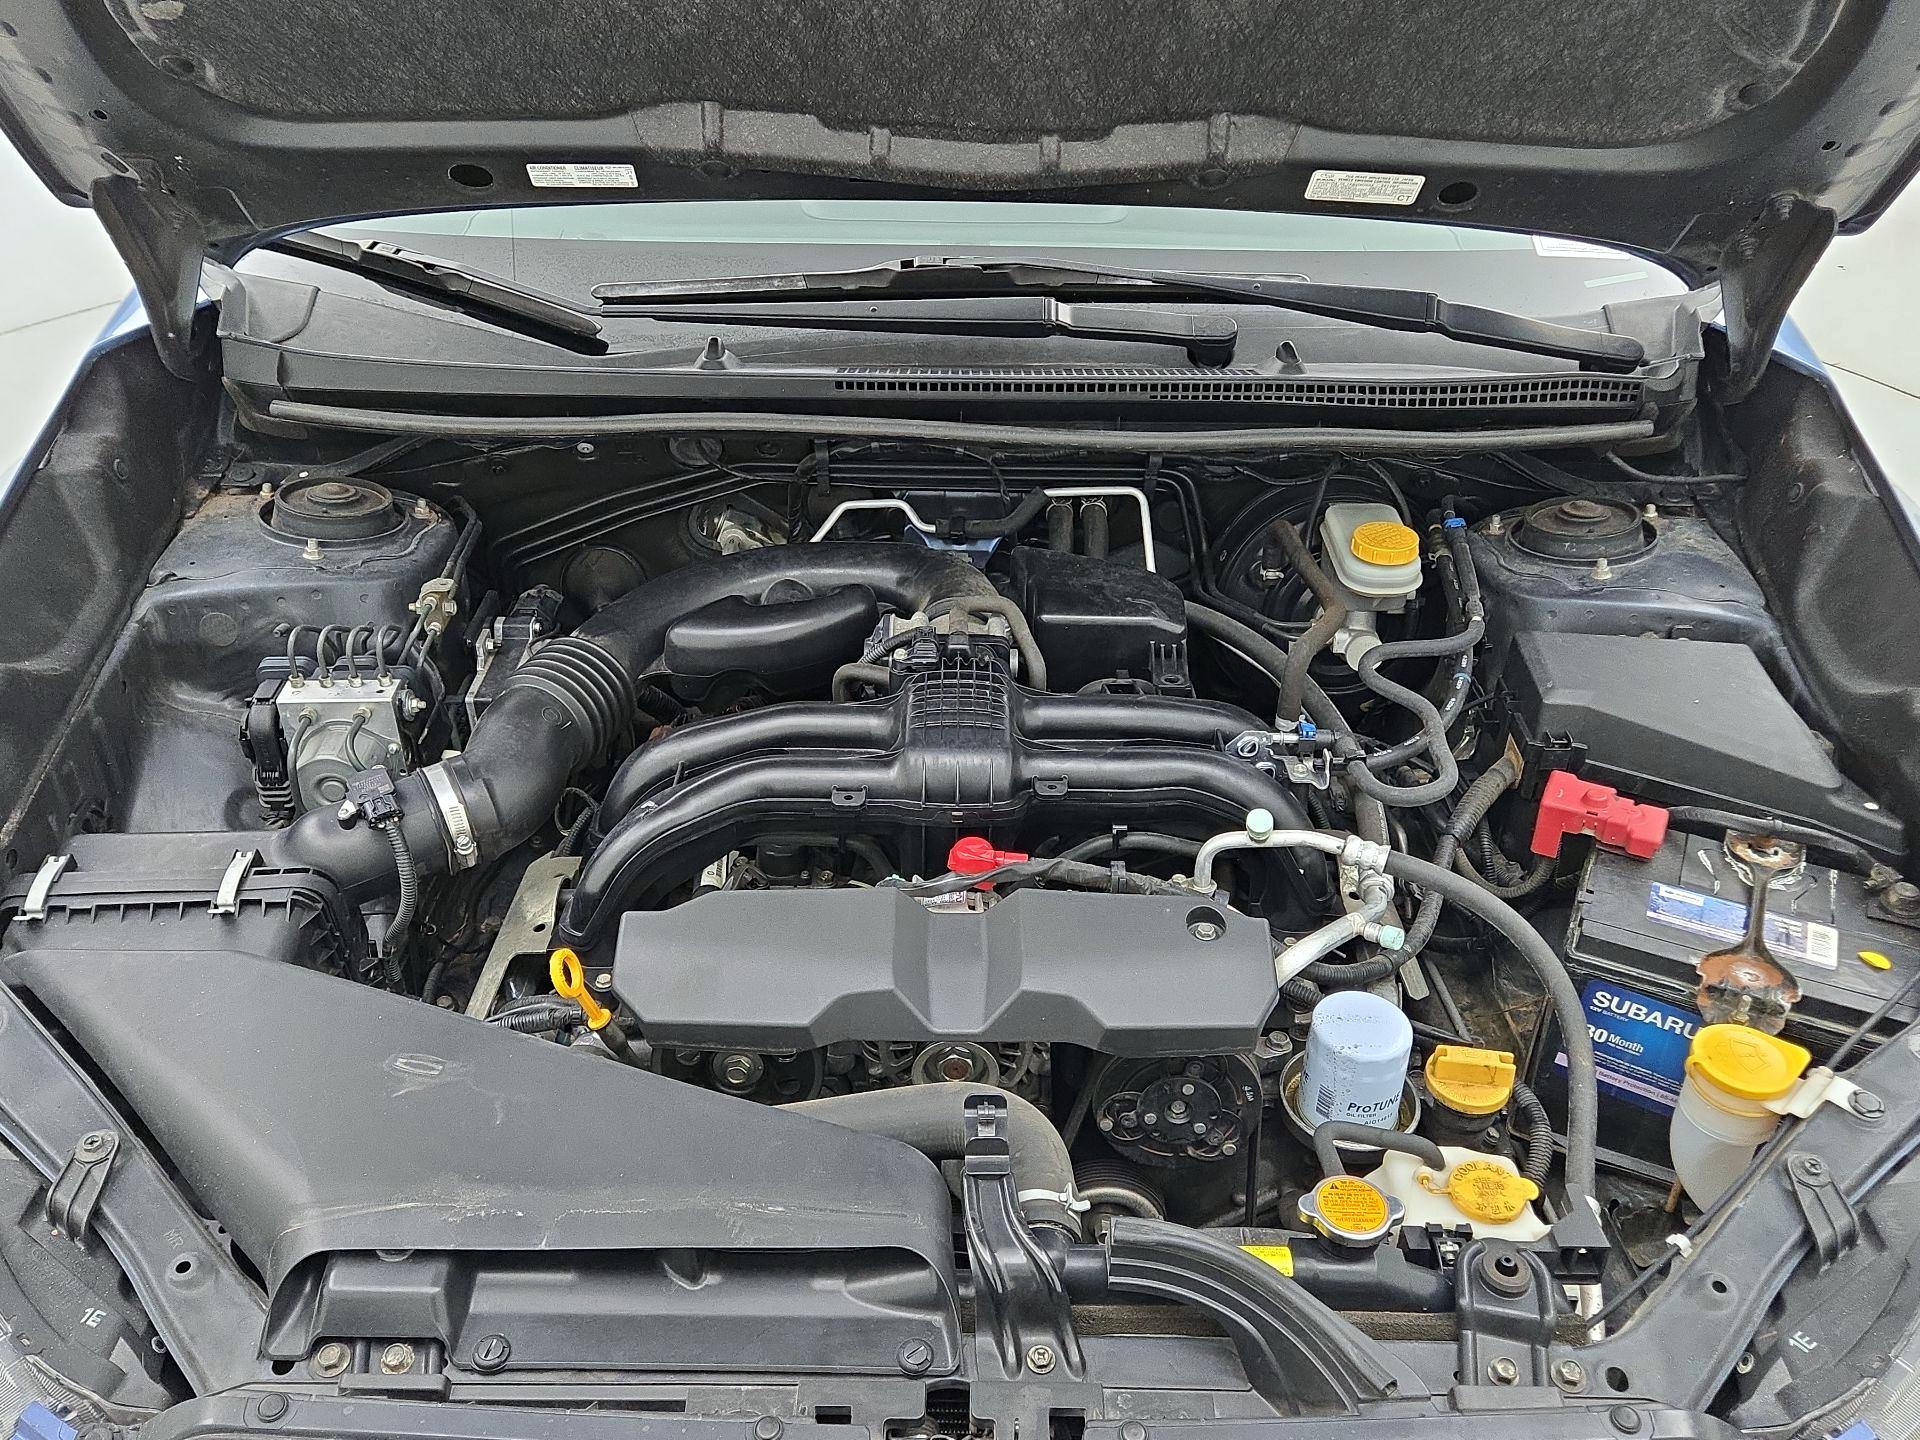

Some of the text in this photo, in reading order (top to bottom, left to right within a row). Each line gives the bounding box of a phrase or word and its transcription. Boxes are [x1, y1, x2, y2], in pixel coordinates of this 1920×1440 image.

[1396, 194, 1412, 202] CT
[1592, 990, 1703, 1040] SUBARU
[1602, 1009, 1629, 1022] BATTERY
[1608, 1034, 1644, 1054] Month
[1453, 1162, 1513, 1182] COOLANT
[80, 1307, 107, 1329] 1E
[1788, 1330, 1818, 1353] 1E
